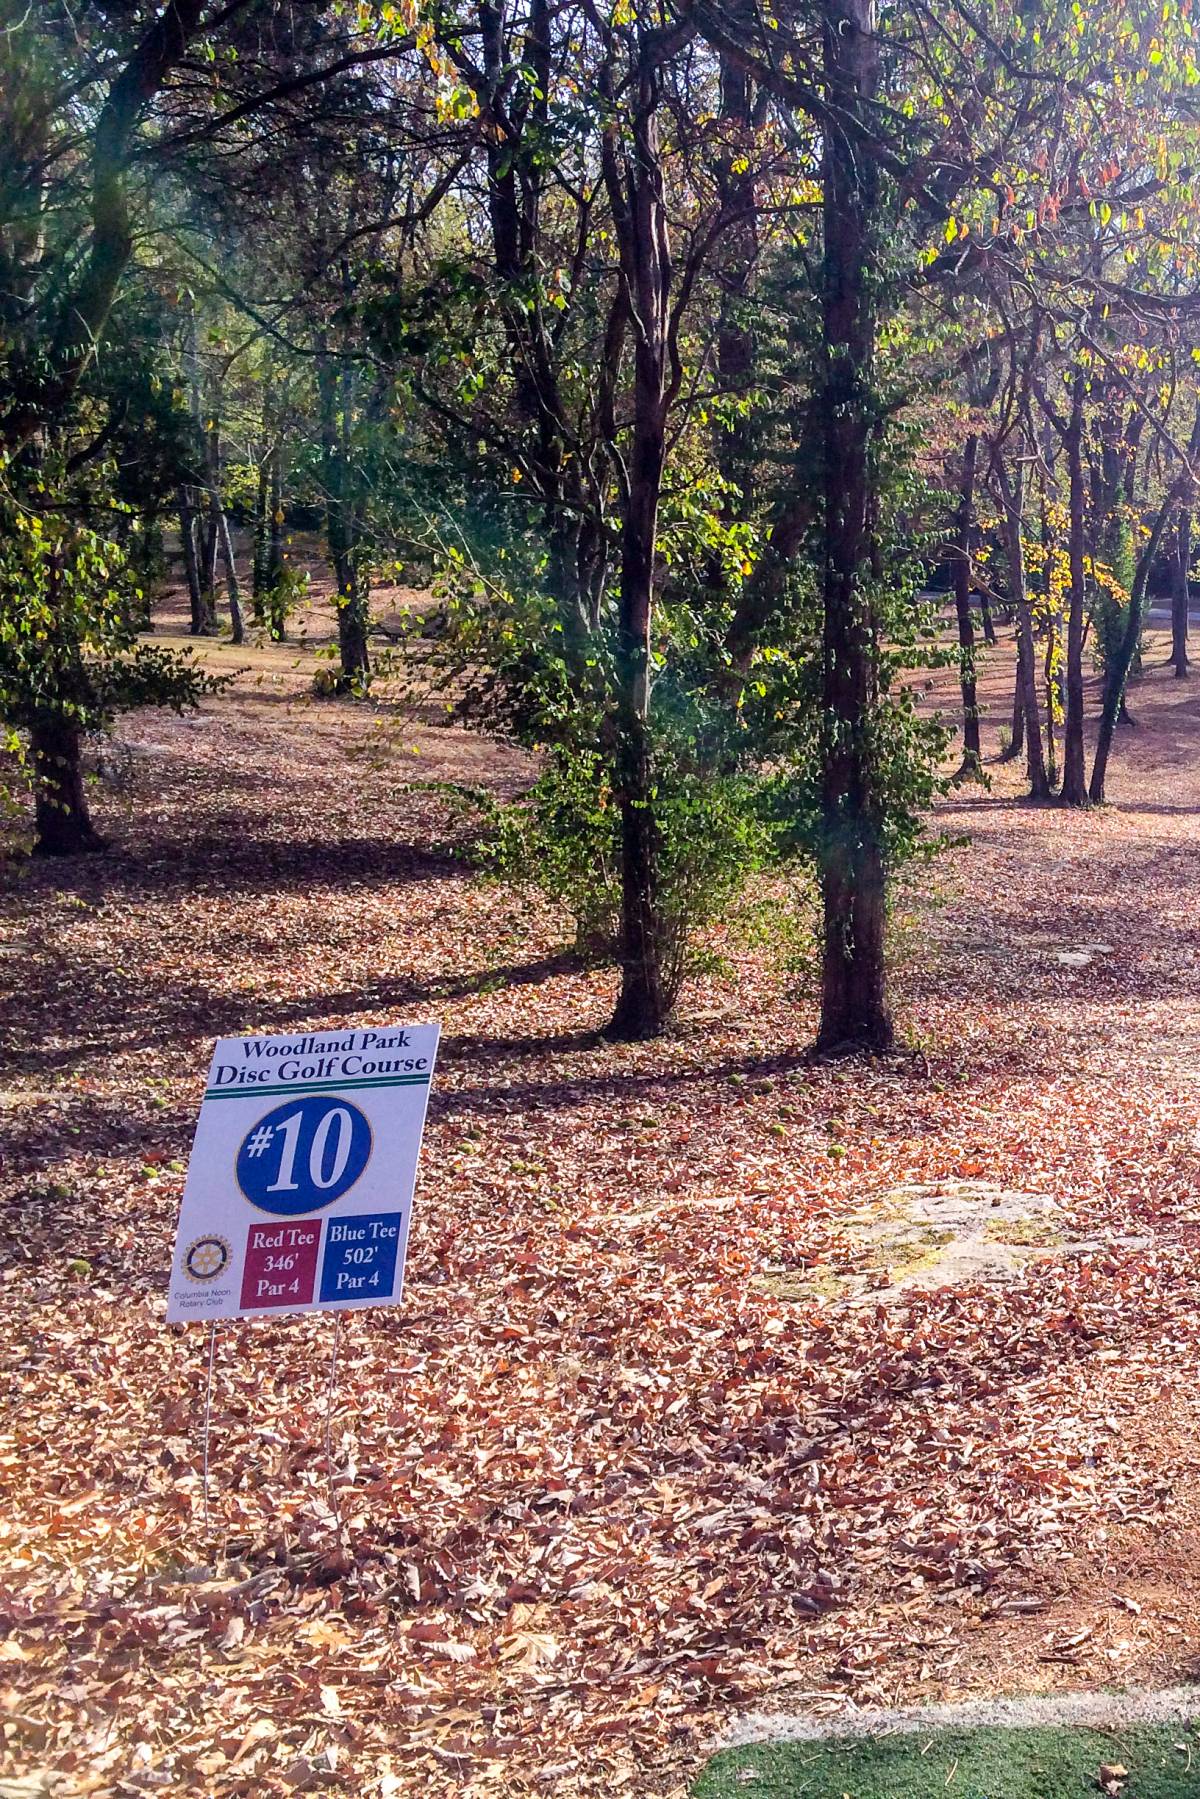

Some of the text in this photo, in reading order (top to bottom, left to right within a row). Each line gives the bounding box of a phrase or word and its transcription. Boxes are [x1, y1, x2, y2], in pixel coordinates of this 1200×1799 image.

[243, 1031, 411, 1058] Woodland Park
[215, 1055, 428, 1085] Disc Golf Course
[247, 1108, 353, 1192] #10
[253, 1229, 315, 1248] Red Tee
[330, 1221, 397, 1242] Blue Tee
[263, 1253, 300, 1272] 346'
[342, 1246, 379, 1265] 502'
[256, 1278, 300, 1297] Par 4
[335, 1270, 380, 1290] Par 4
[174, 1289, 231, 1299] Columbia Noon
[179, 1298, 223, 1308] Rotary Club
